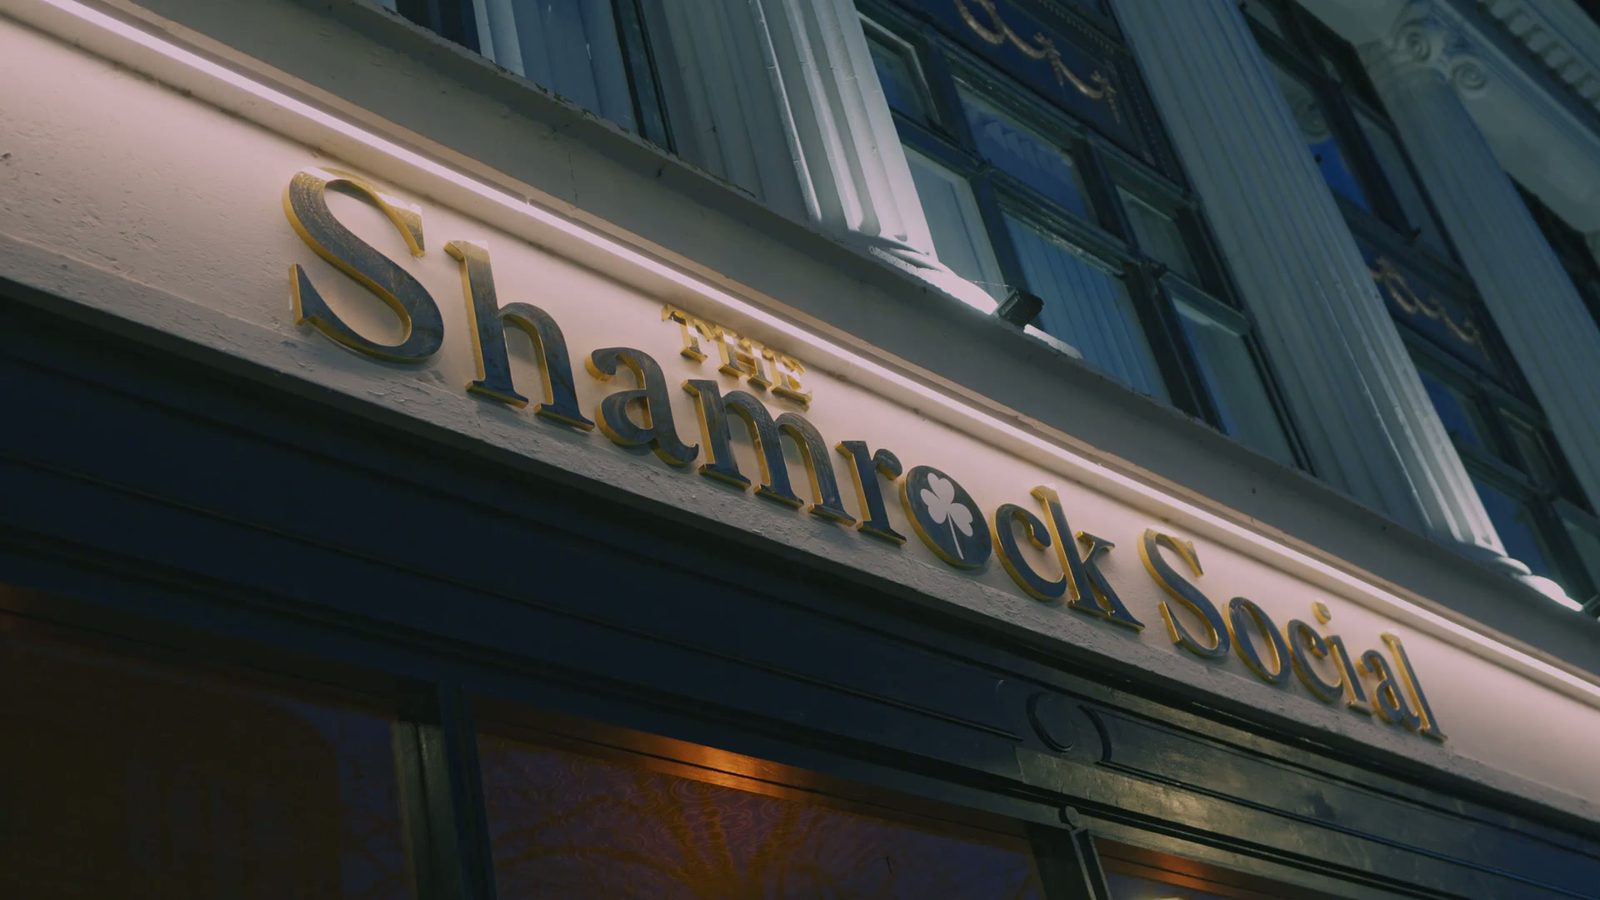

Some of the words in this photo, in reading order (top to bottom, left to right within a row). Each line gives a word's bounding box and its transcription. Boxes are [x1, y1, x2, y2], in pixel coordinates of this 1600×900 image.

[283, 167, 1145, 632] Shamrock
[1138, 528, 1447, 743] Social
[661, 303, 813, 411] THE
